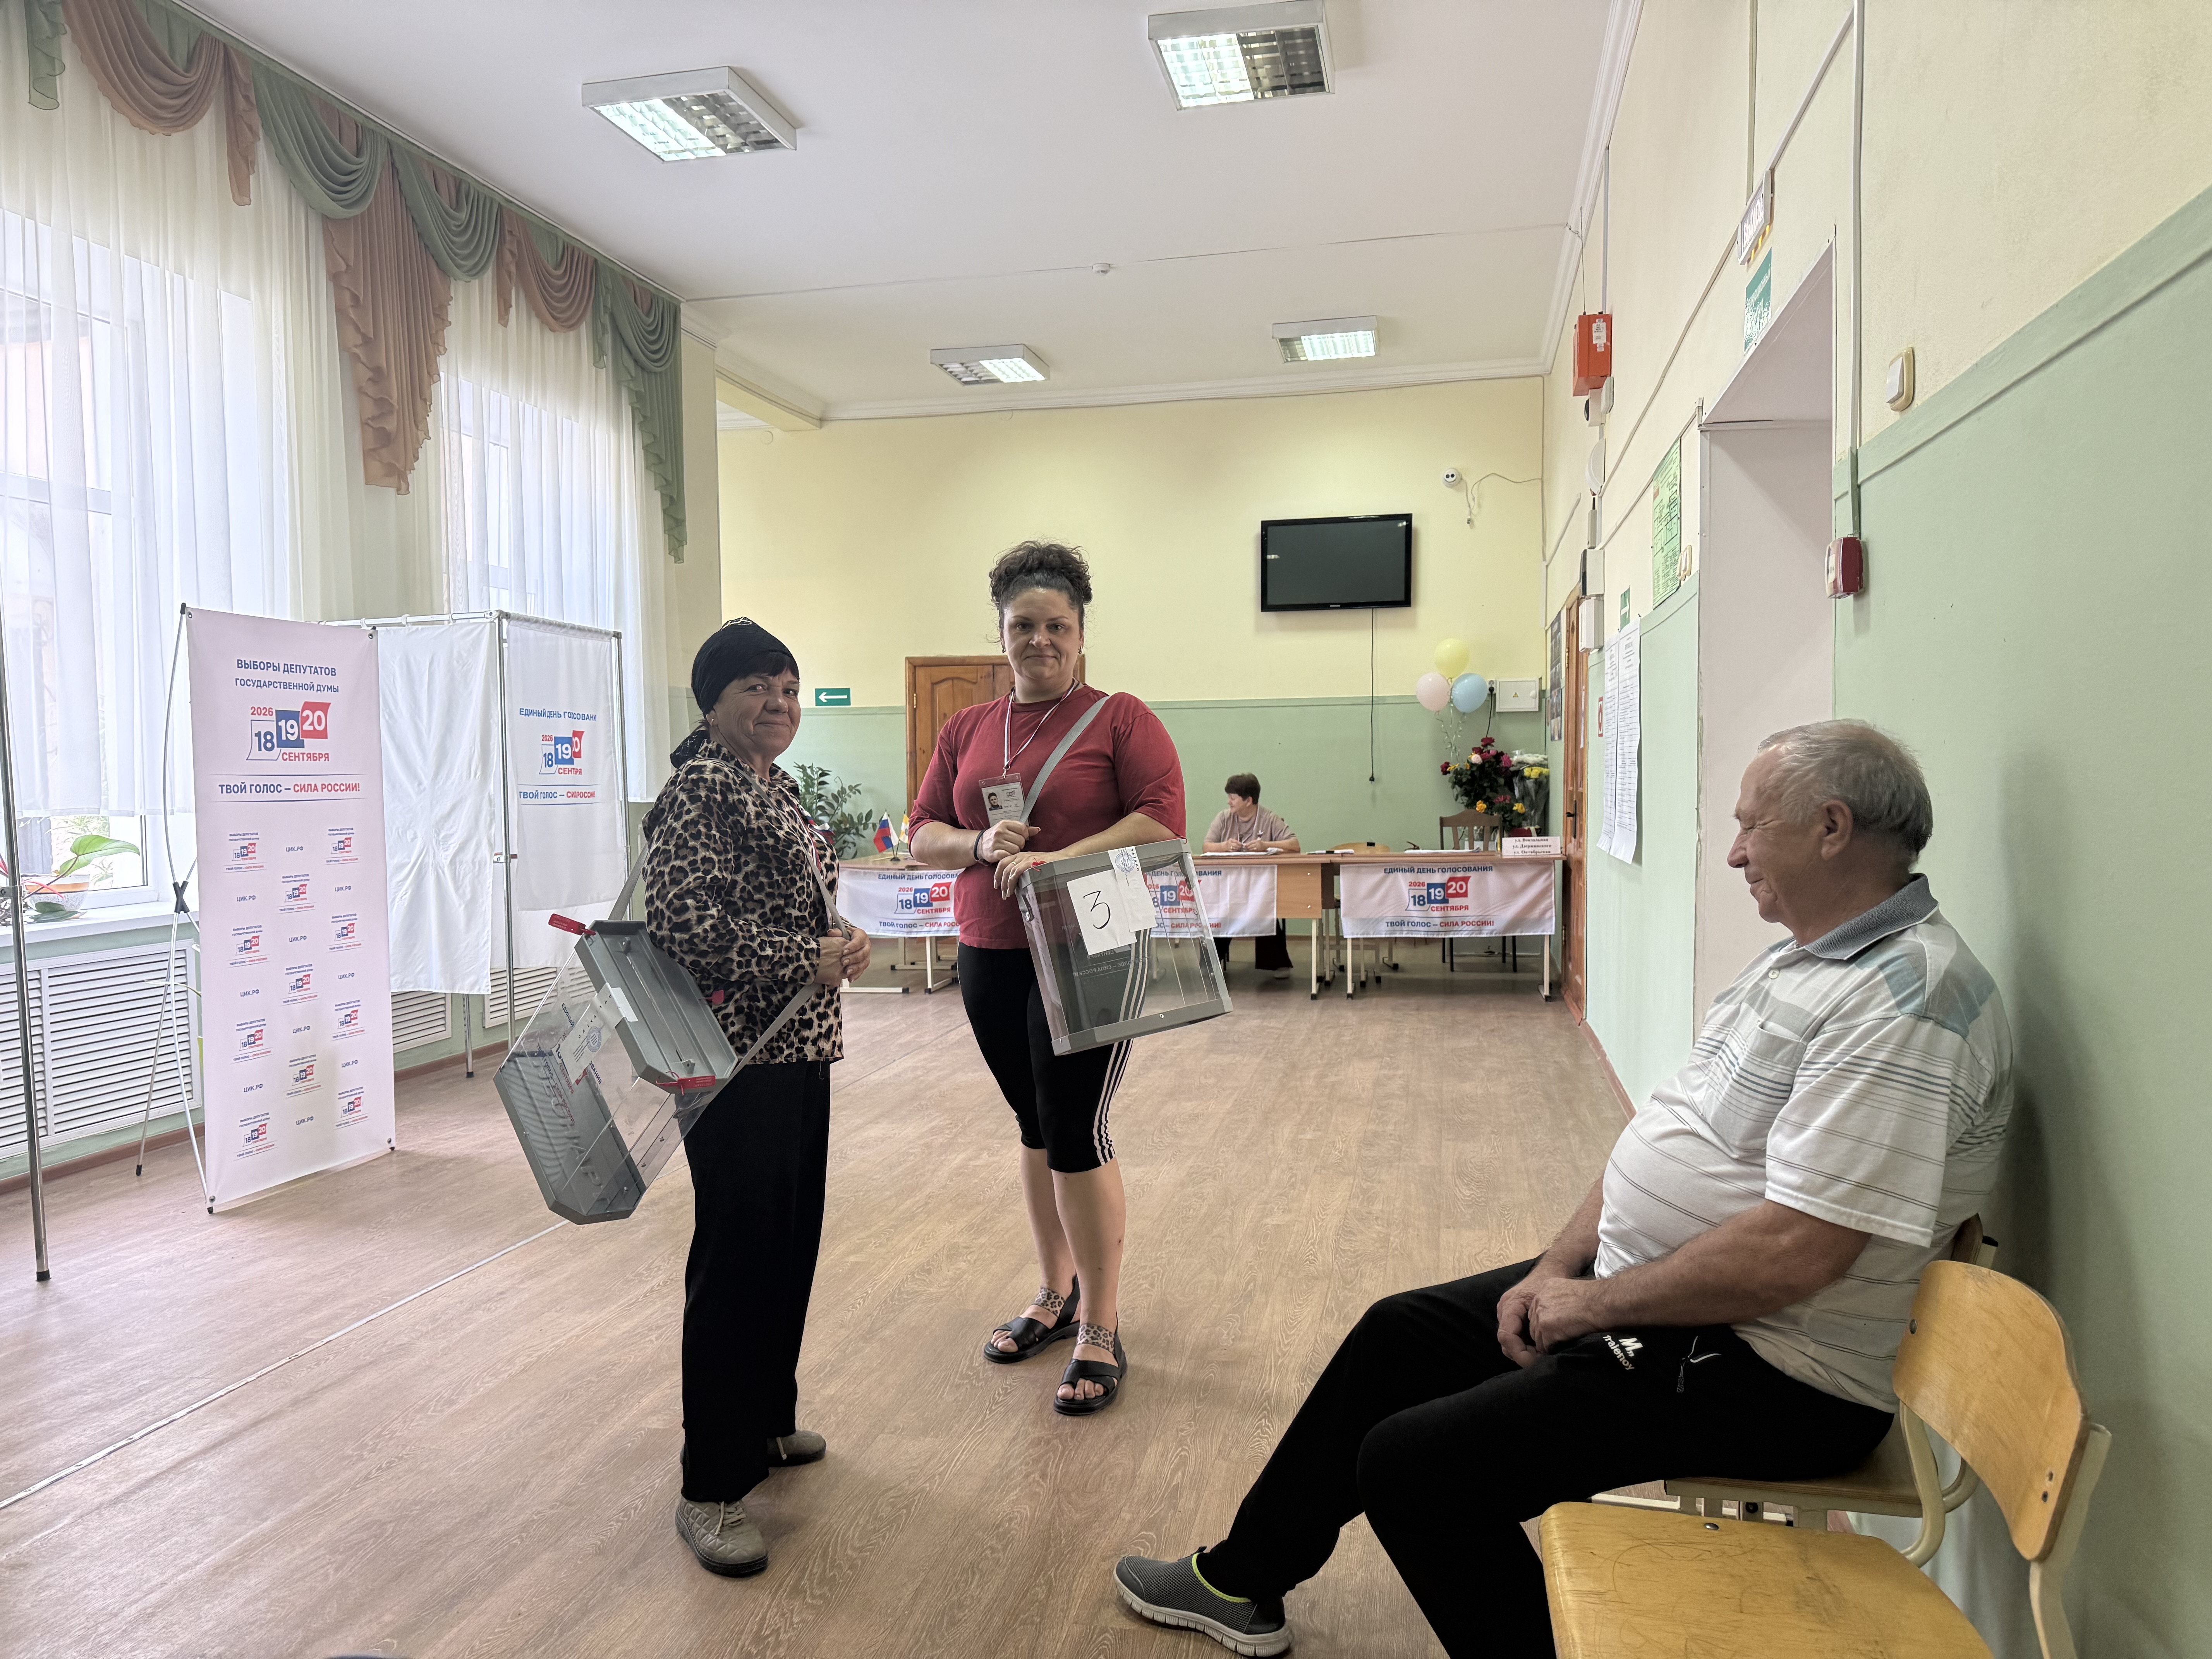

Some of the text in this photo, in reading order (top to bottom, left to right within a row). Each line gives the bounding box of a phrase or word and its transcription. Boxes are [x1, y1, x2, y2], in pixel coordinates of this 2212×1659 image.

[237, 659, 337, 676] ВЫБОРЫ ДЕПУТАТОВ
[235, 678, 339, 693] ГОСУДАРСТВЕННОЙ ДУМЫ
[251, 706, 273, 716] 2026
[519, 708, 546, 717] ЕДИНЫЙ
[546, 711, 562, 719] ДЕНЬ
[254, 710, 326, 752] 18 19 20
[282, 752, 330, 761] СЕНТЯБРЯ
[543, 737, 580, 768] 18 19 0
[218, 781, 247, 794] ТВОЙ
[250, 784, 282, 793] ГОЛОС
[293, 783, 319, 793] СИЛА
[321, 783, 360, 792] РОССИИ!
[899, 886, 948, 909] 18 19 20
[1162, 891, 1176, 902] 19
[1411, 881, 1466, 906] 18 19 20
[1083, 890, 1111, 929] 3
